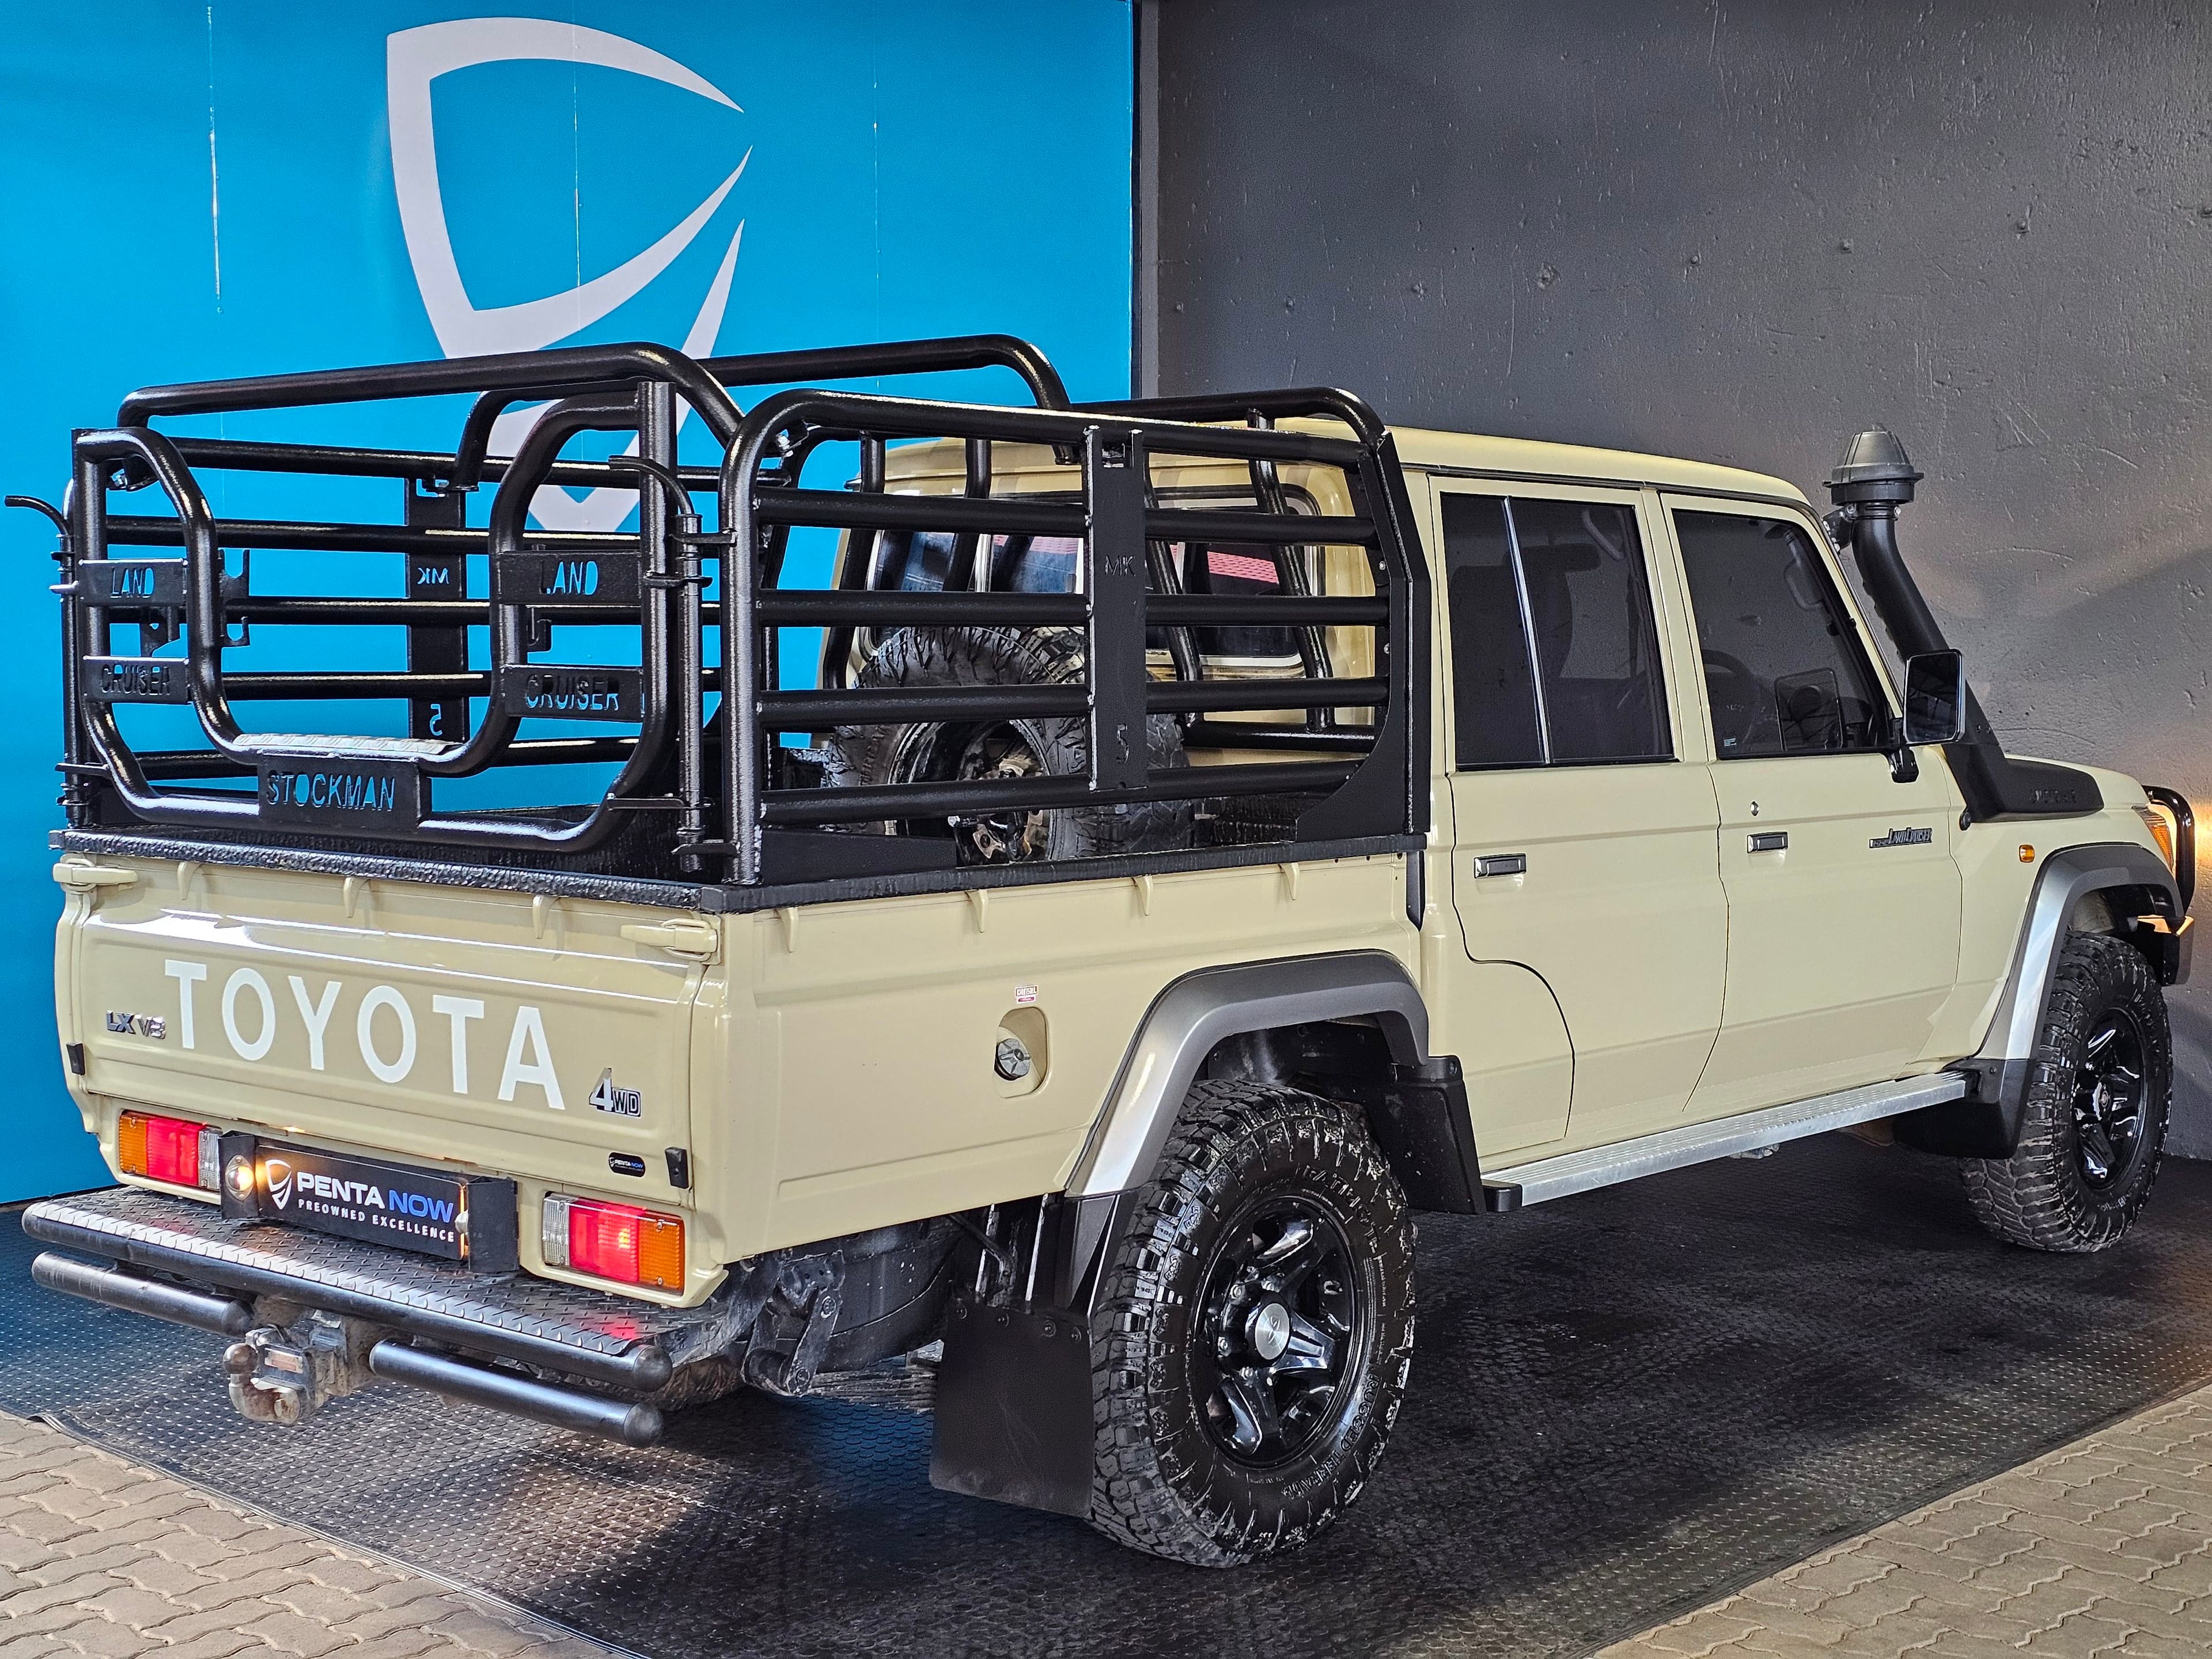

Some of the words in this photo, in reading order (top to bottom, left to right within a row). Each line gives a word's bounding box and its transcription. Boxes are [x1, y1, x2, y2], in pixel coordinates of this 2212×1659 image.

[111, 567, 155, 599] LAND
[539, 560, 599, 596] LAND
[1104, 554, 1137, 577] MK
[101, 664, 171, 696] CRUISER
[525, 674, 620, 711] CRUISER
[267, 770, 396, 812] STOCKMAN
[106, 1010, 136, 1035] LX
[134, 1014, 166, 1040] V8
[165, 959, 566, 1111] TOYOTA
[589, 1067, 642, 1118] 4WD
[297, 1171, 385, 1210] PENTA
[389, 1190, 454, 1224] NOW
[298, 1198, 366, 1222] PREOWNED
[372, 1214, 454, 1243] EXCELLENCE
